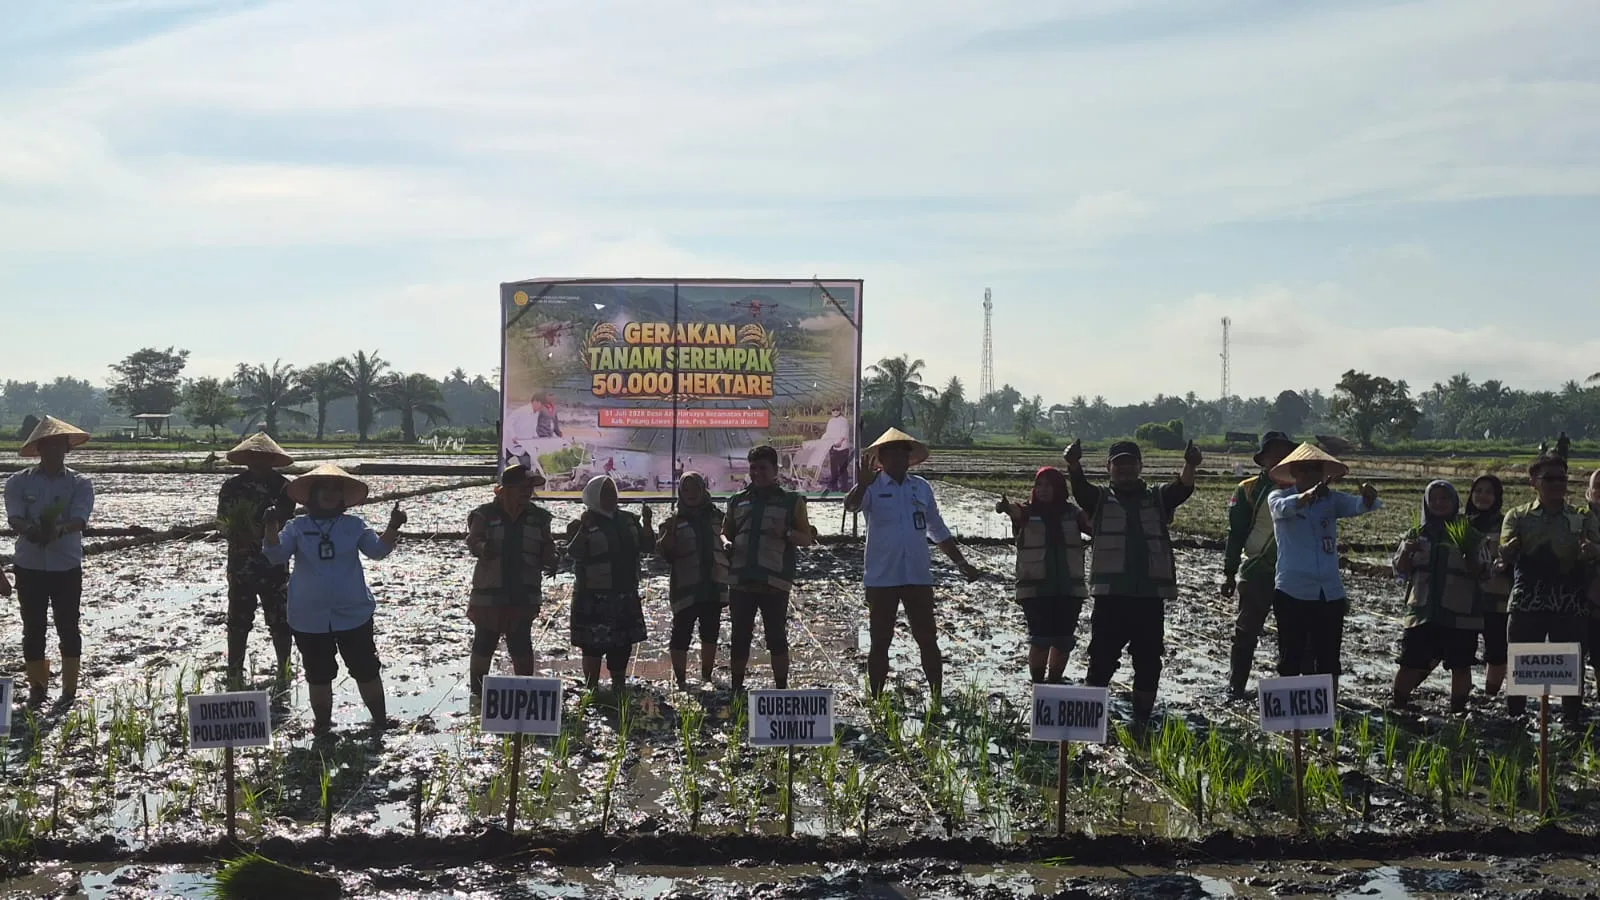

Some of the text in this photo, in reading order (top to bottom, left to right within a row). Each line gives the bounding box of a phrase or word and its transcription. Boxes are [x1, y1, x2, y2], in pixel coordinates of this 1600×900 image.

[624, 322, 736, 345] GERAKAN
[588, 346, 774, 372] TANAM SEREMPAK
[592, 372, 773, 396] 50.000 HEKTARE
[1520, 655, 1564, 665] KADIS
[1512, 670, 1572, 678] PERTANIAN
[200, 700, 256, 720] DIREKTUR
[486, 689, 557, 721] BUPATI
[758, 696, 827, 716] GUBERNUR
[1036, 699, 1104, 728] Ka. BBRMP
[1264, 688, 1328, 718] Ka. KELSI
[193, 722, 266, 742] POLBANGTAN
[769, 720, 816, 740] SUMUT
